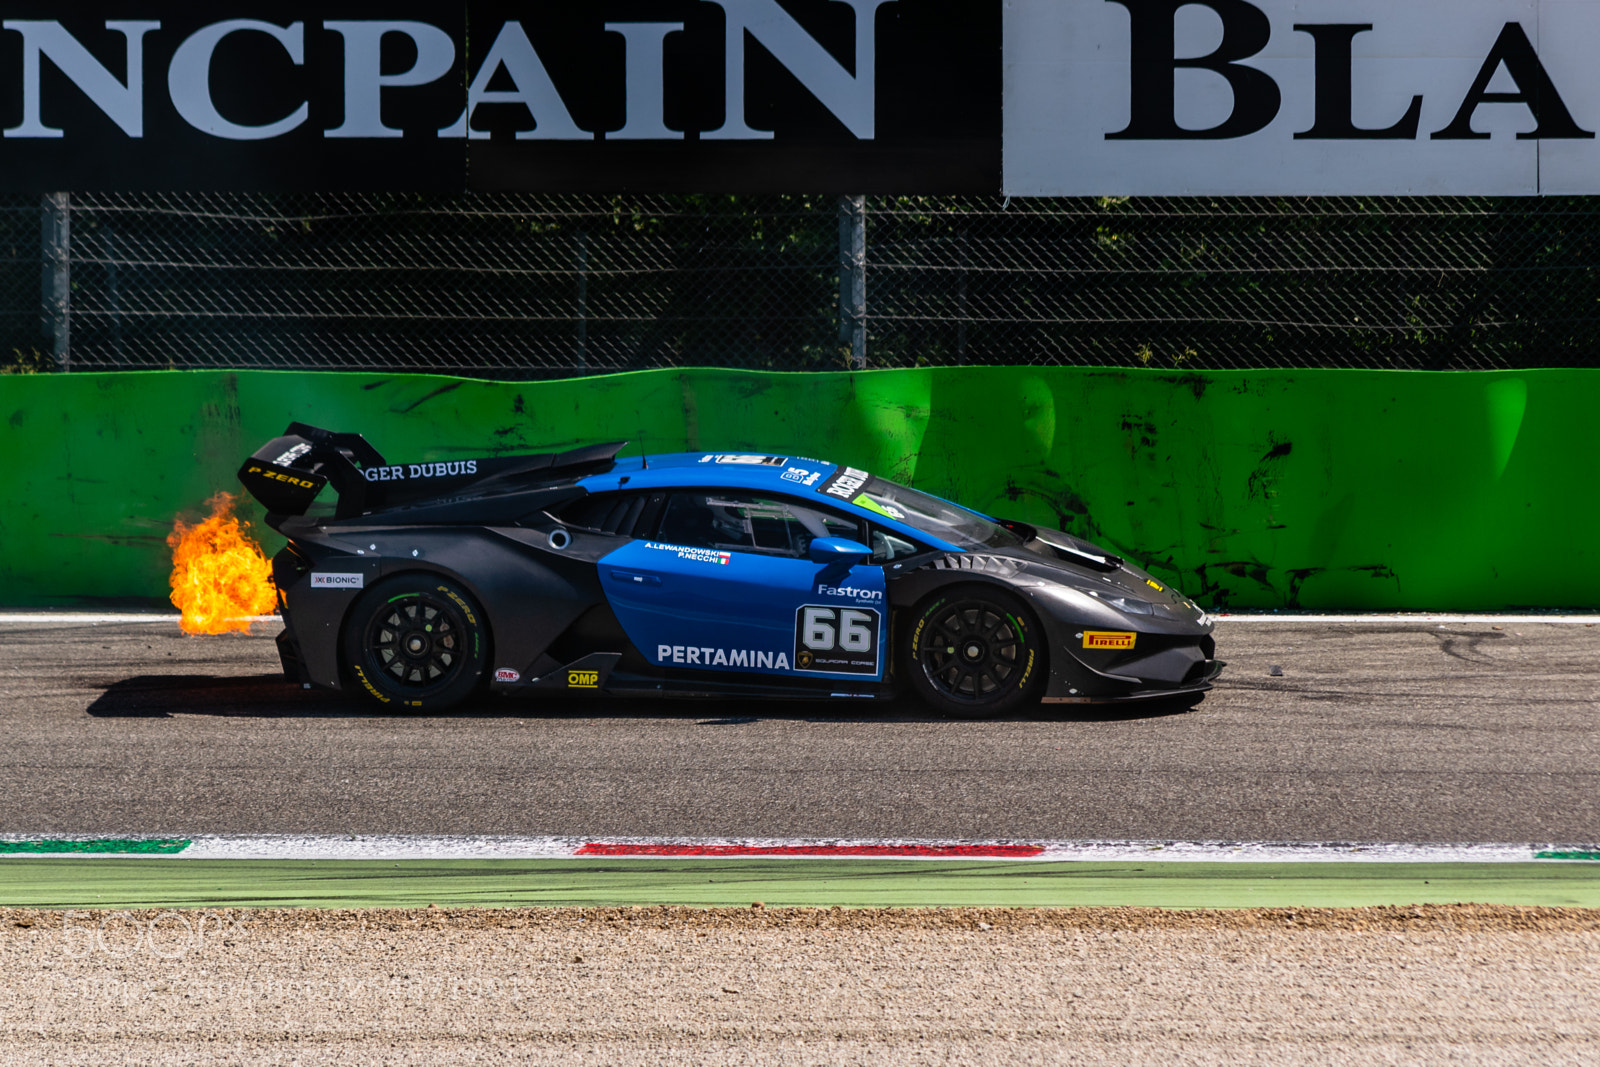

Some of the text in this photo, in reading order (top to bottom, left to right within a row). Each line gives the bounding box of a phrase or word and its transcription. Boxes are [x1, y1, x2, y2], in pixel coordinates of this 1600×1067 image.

[3, 0, 897, 141] NCPAIN
[1104, 0, 1595, 140] BLA
[248, 466, 314, 489] P ZERO
[409, 460, 478, 479] DUBUIS
[644, 542, 720, 558] A.LEWANDOWSKI
[677, 551, 719, 564] P.NECCHI
[817, 583, 883, 600] Fastron
[447, 591, 477, 624] ZERO
[802, 606, 873, 653] 66
[1088, 634, 1132, 647] PIRELLI
[657, 644, 790, 670] PERTAMINA
[568, 673, 599, 685] OMP
